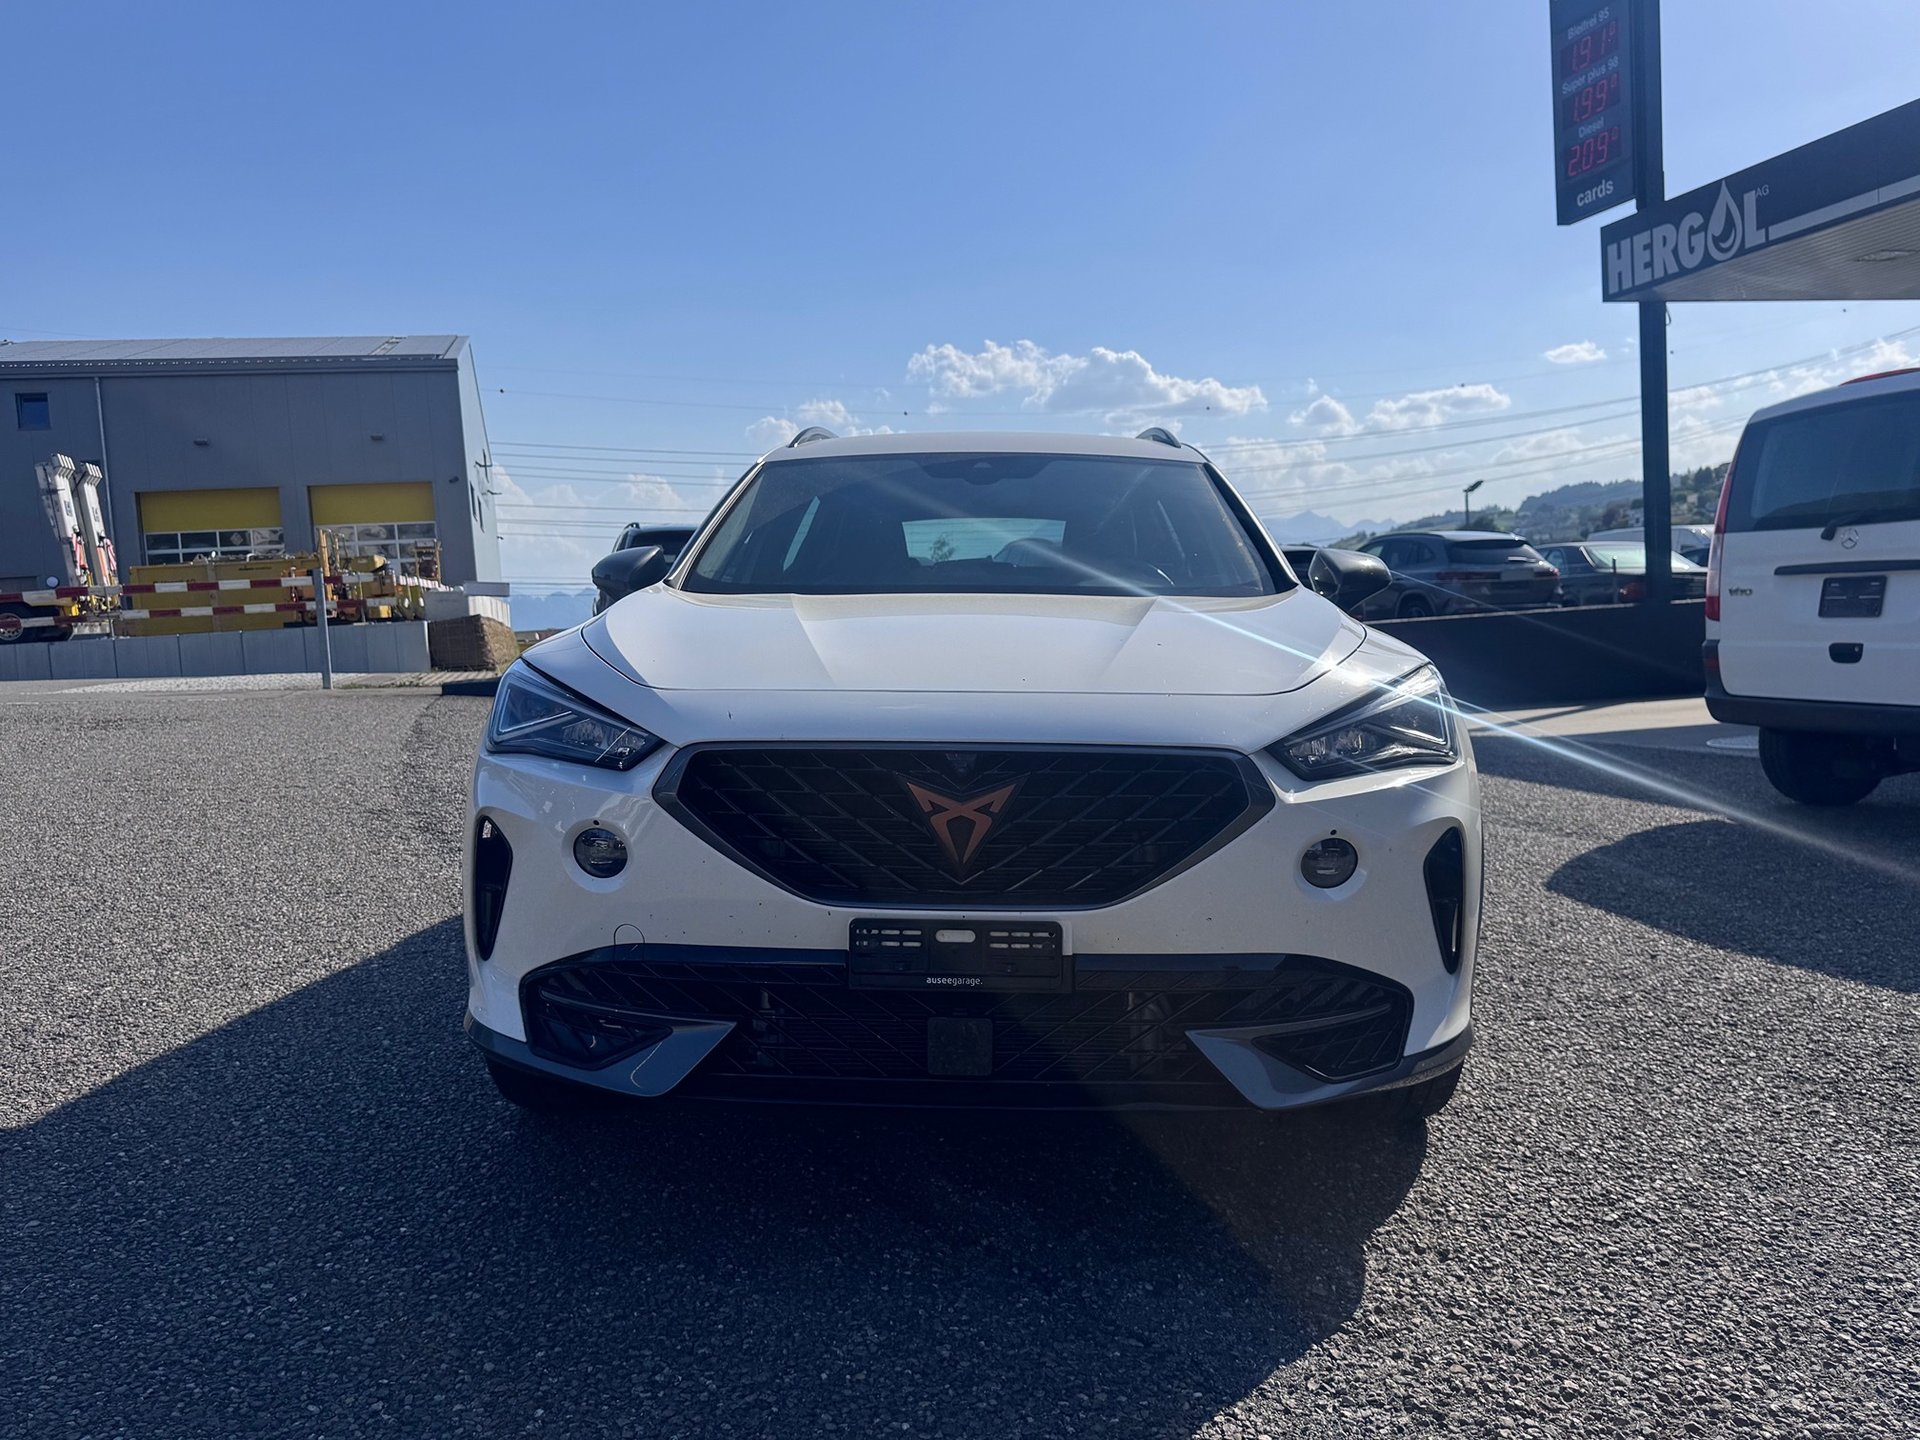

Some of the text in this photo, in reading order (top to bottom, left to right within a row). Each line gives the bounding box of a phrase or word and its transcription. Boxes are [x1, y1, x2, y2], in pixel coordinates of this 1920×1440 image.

[1587, 63, 1606, 84] plus
[1576, 179, 1614, 207] cards
[1755, 184, 1770, 198] AG
